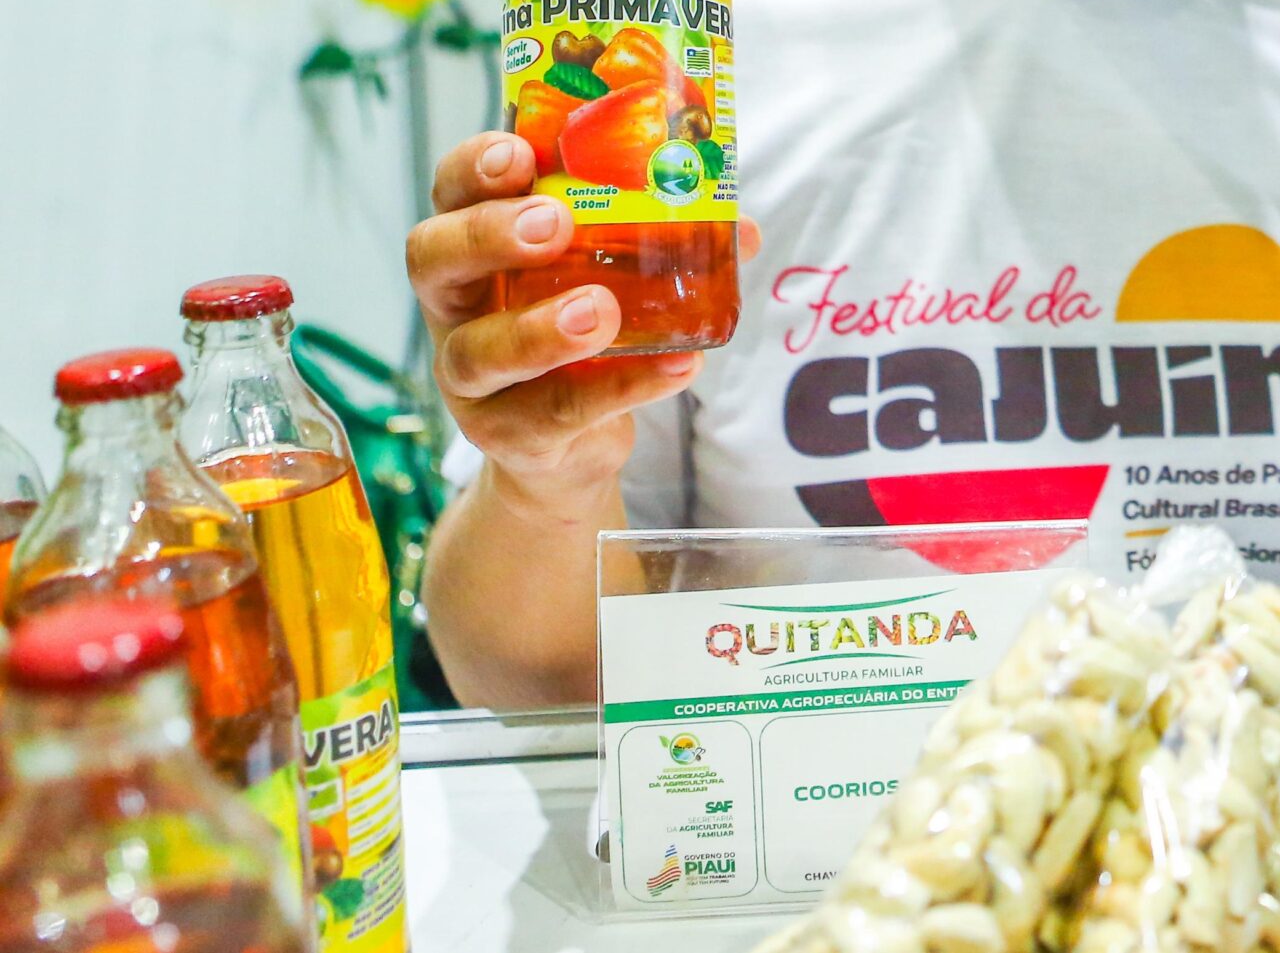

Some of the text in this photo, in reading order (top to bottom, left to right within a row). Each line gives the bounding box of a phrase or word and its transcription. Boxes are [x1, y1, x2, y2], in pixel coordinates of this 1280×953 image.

[573, 199, 610, 209] 500ml
[771, 264, 1102, 354] Festival da
[1124, 465, 1150, 486] 10
[1155, 465, 1220, 485] Anos
[1225, 464, 1256, 485] de
[1123, 498, 1220, 520] Cultural
[705, 609, 978, 666] QUITANDA
[764, 665, 924, 686] AGRICULTURA FAMILIAR
[674, 699, 778, 716] COOPERATIVA
[781, 689, 898, 709] AGROPECUÁRIA
[902, 689, 923, 700] DO
[304, 702, 393, 767] VERA
[663, 778, 725, 787] AGRICULTURA
[705, 800, 734, 814] SAF
[680, 823, 734, 832] AGRICULTURA
[697, 831, 734, 839] FAMILIAR
[684, 853, 722, 861] GOVERNO
[804, 871, 837, 881] CHAV
